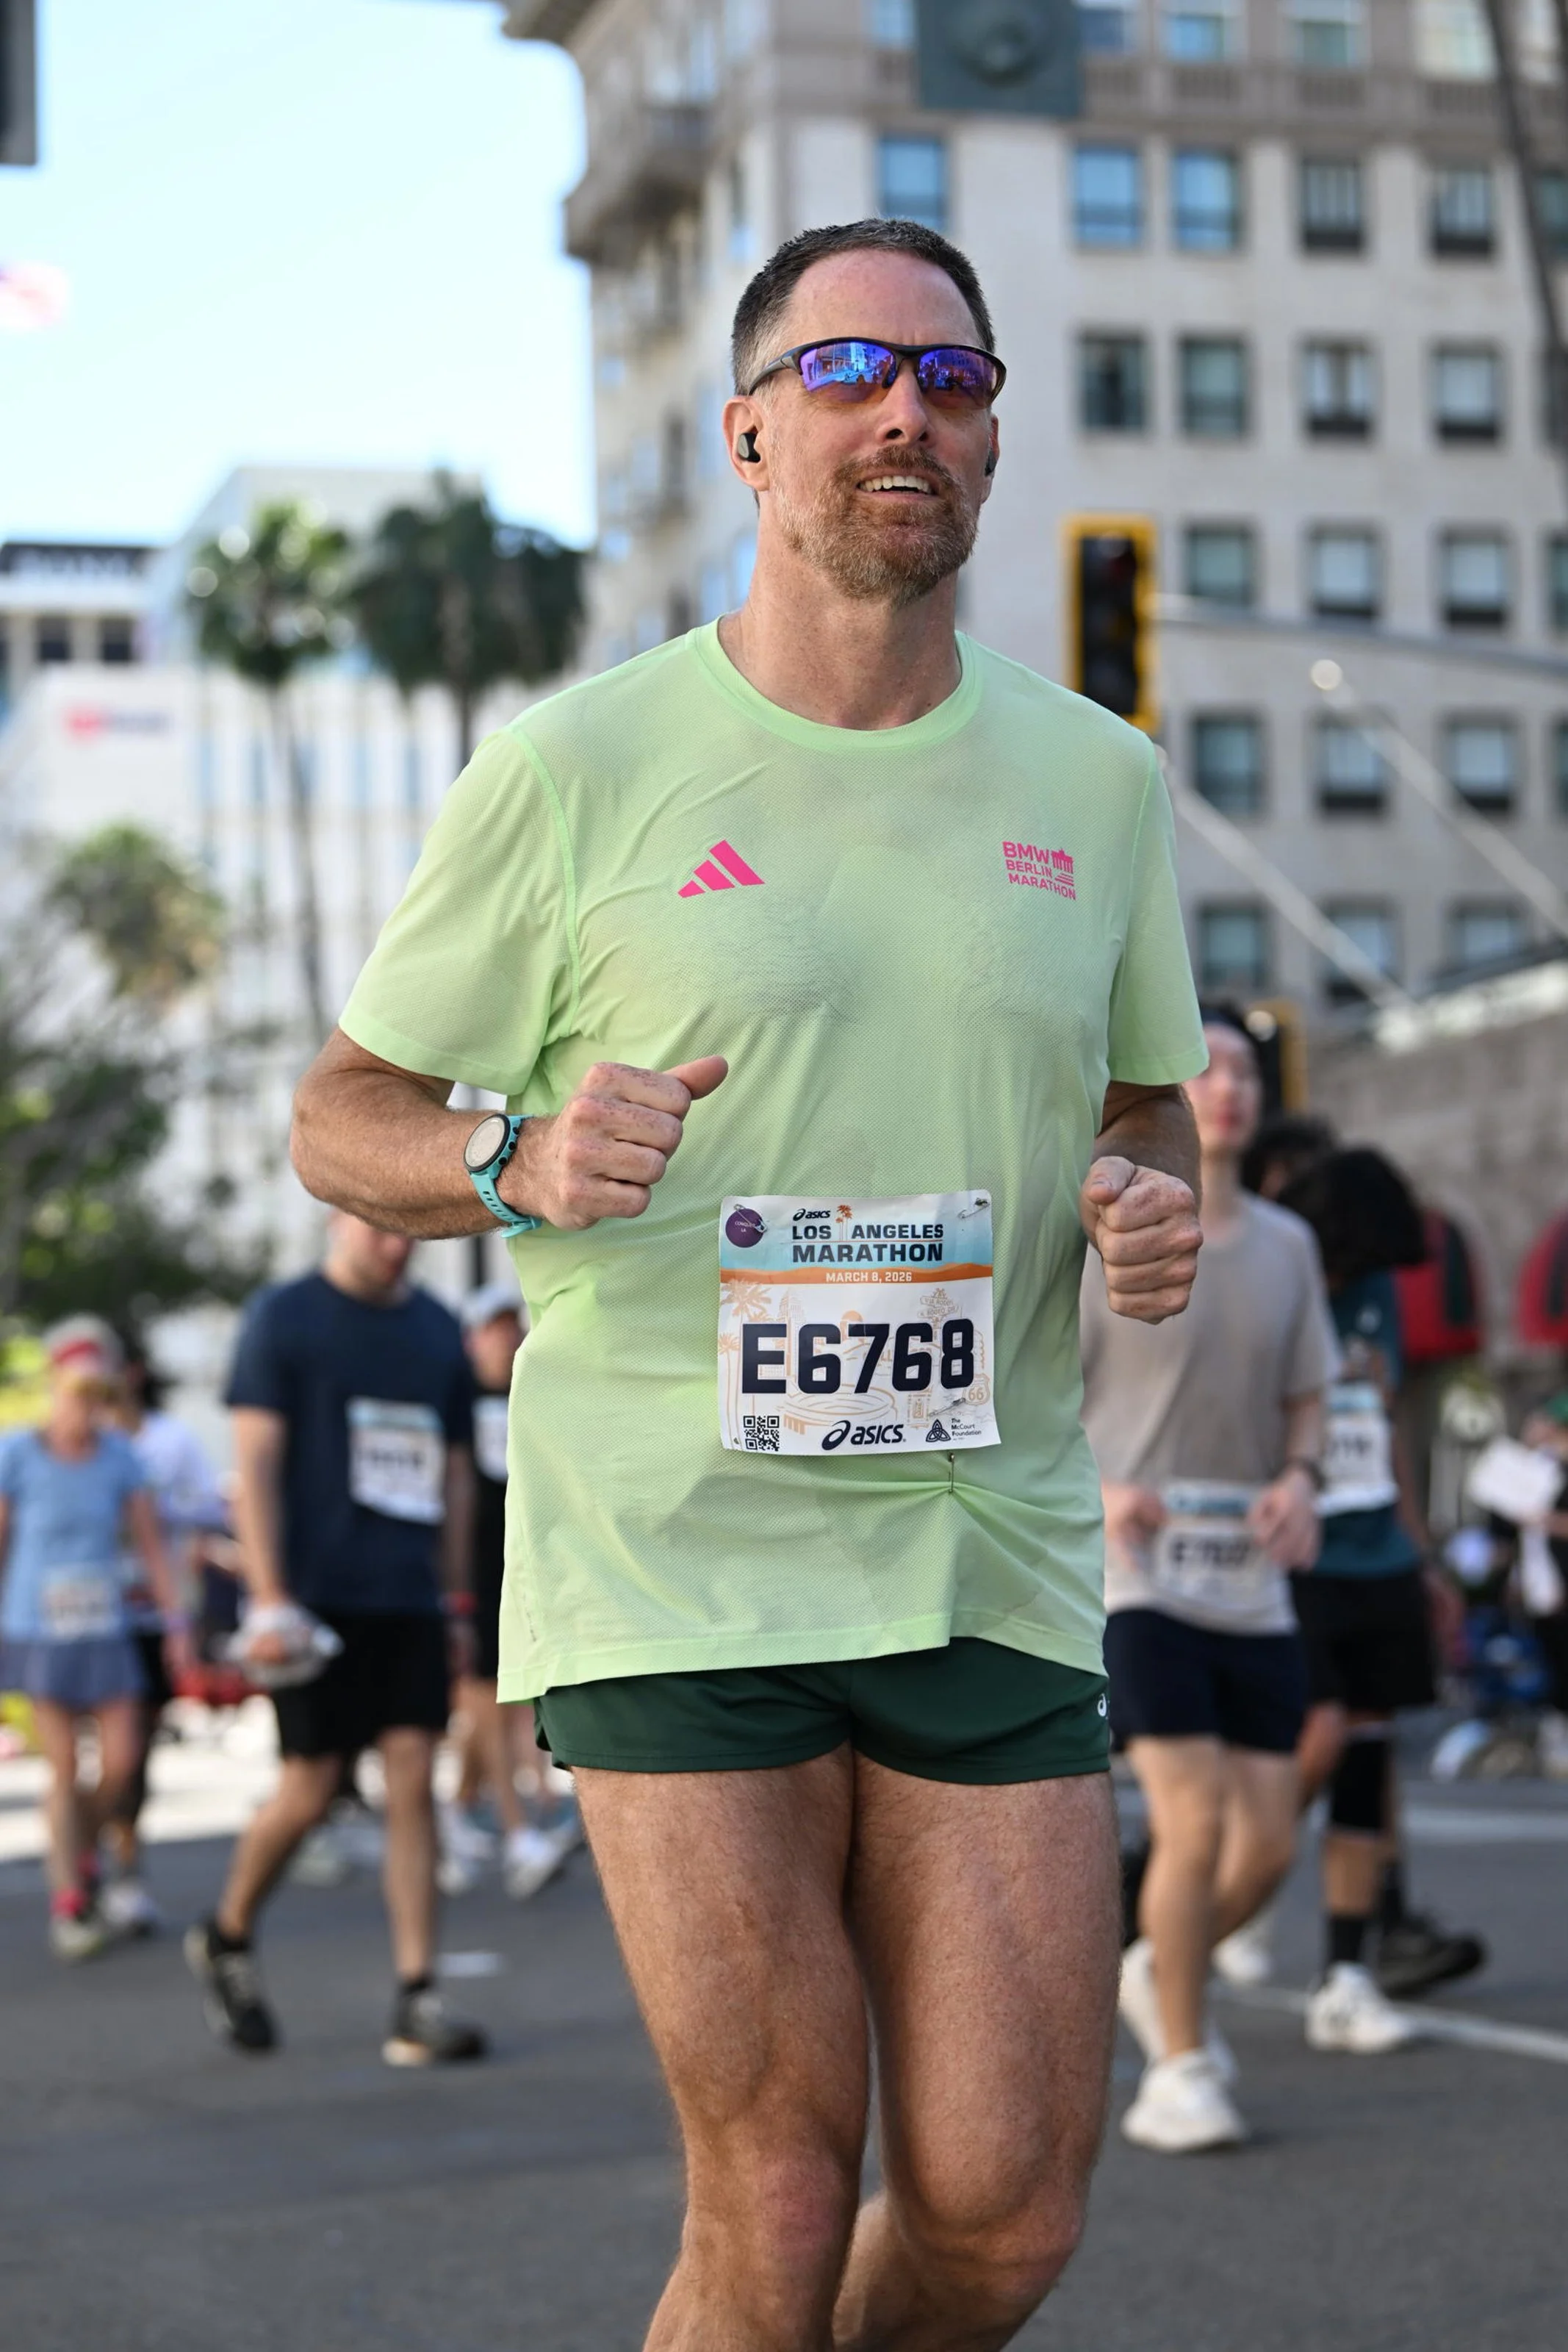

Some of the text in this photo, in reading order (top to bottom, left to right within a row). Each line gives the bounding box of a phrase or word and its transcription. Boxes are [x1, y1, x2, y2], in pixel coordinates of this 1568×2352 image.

[1002, 841, 1049, 864] BMW
[1005, 859, 1052, 878] BERLIN
[1008, 872, 1076, 900] MARATHON
[792, 1224, 943, 1240] LOS ANGELES
[792, 1244, 943, 1263] MARATHON
[826, 1272, 912, 1283] MARCH 8, 2026
[742, 1319, 974, 1394] E6768
[968, 1387, 984, 1400] 66
